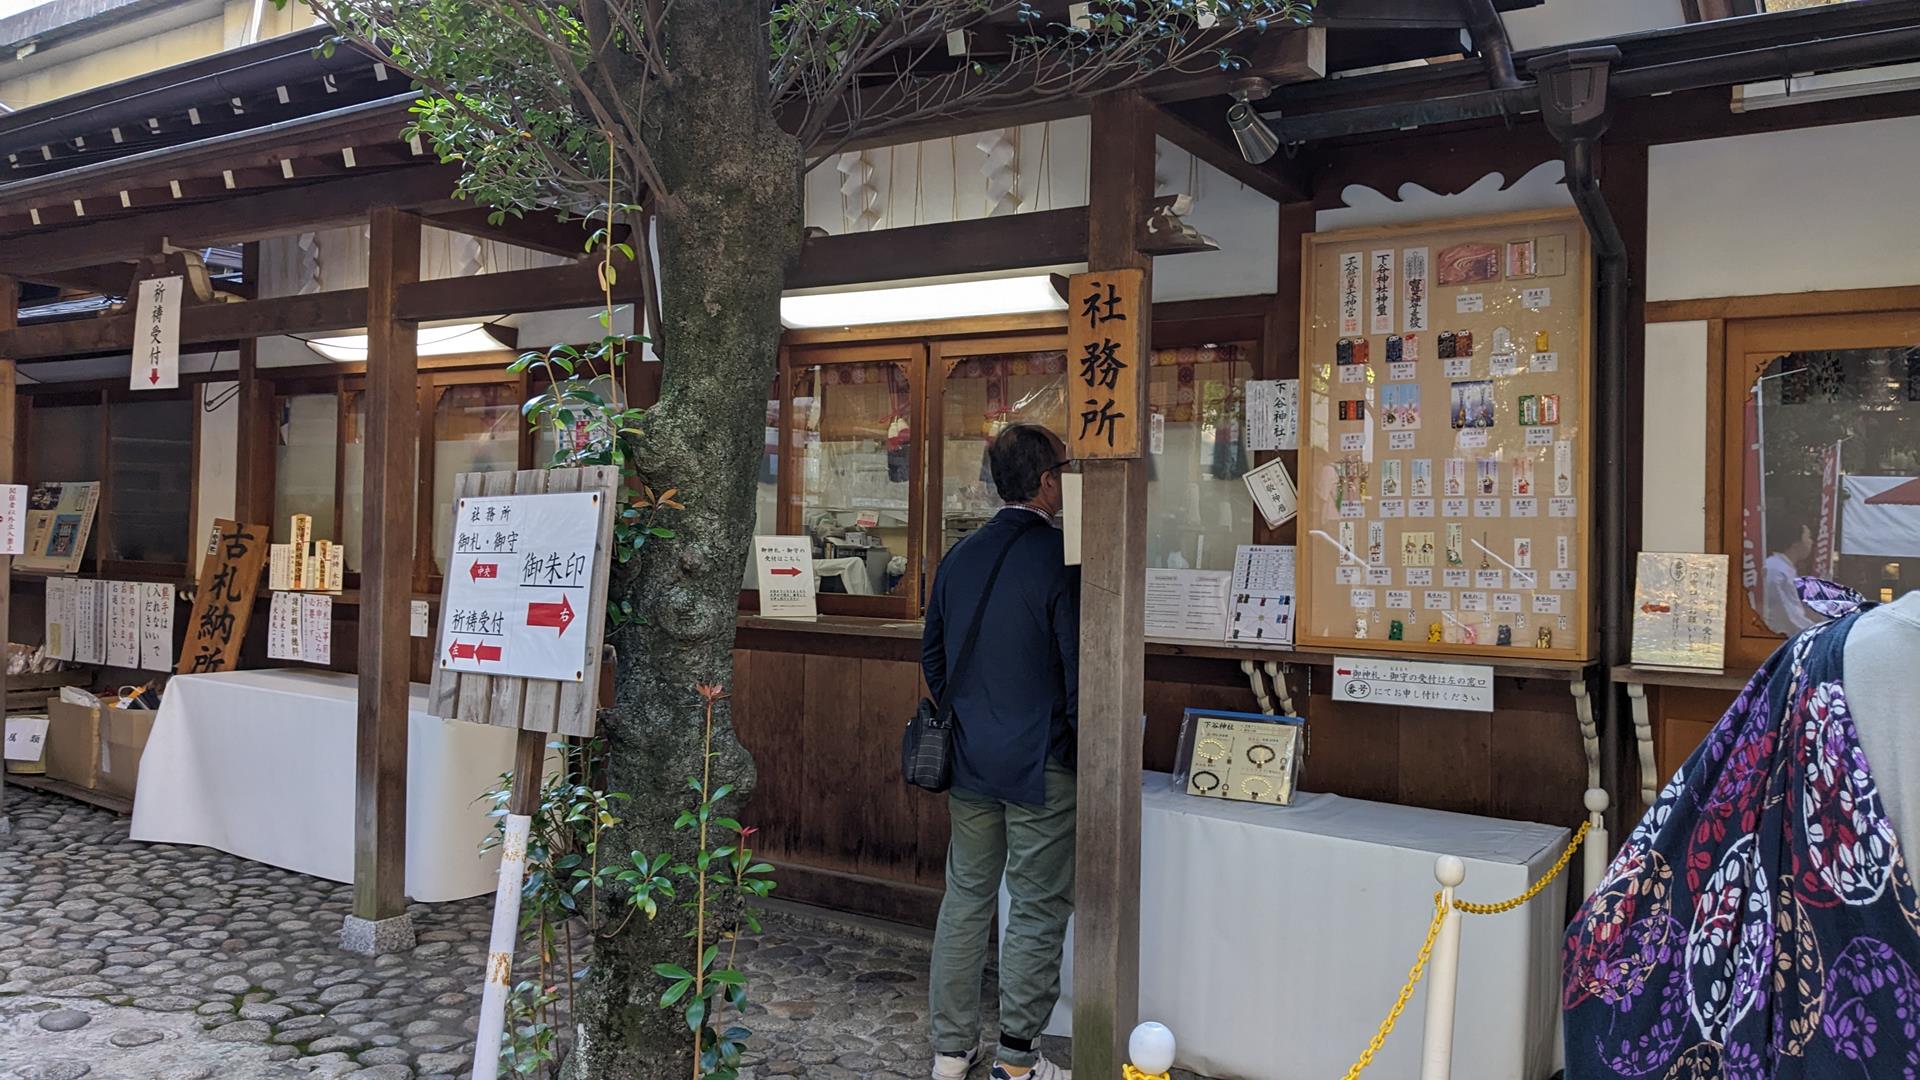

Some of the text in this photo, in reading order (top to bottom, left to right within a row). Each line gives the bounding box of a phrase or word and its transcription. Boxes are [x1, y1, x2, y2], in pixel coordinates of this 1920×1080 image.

[149, 280, 166, 366] 祈祷受付
[1078, 281, 1129, 448] 社務所
[1273, 381, 1288, 438] 下谷神社
[470, 505, 512, 522] 社務所
[457, 530, 519, 552] 御札・御守
[522, 551, 586, 585] 御朱印
[190, 523, 255, 673] 古札納所
[144, 585, 153, 641] ください
[152, 584, 162, 658] 入れないで
[451, 608, 505, 635] 祈祷受付
[560, 608, 570, 621] 右
[451, 645, 459, 656] 左
[1352, 670, 1487, 687] 御神札・御守の受付は左の窓口
[1347, 683, 1481, 702] 番号 にてお申し付けください
[1204, 720, 1235, 731] 下谷神社
